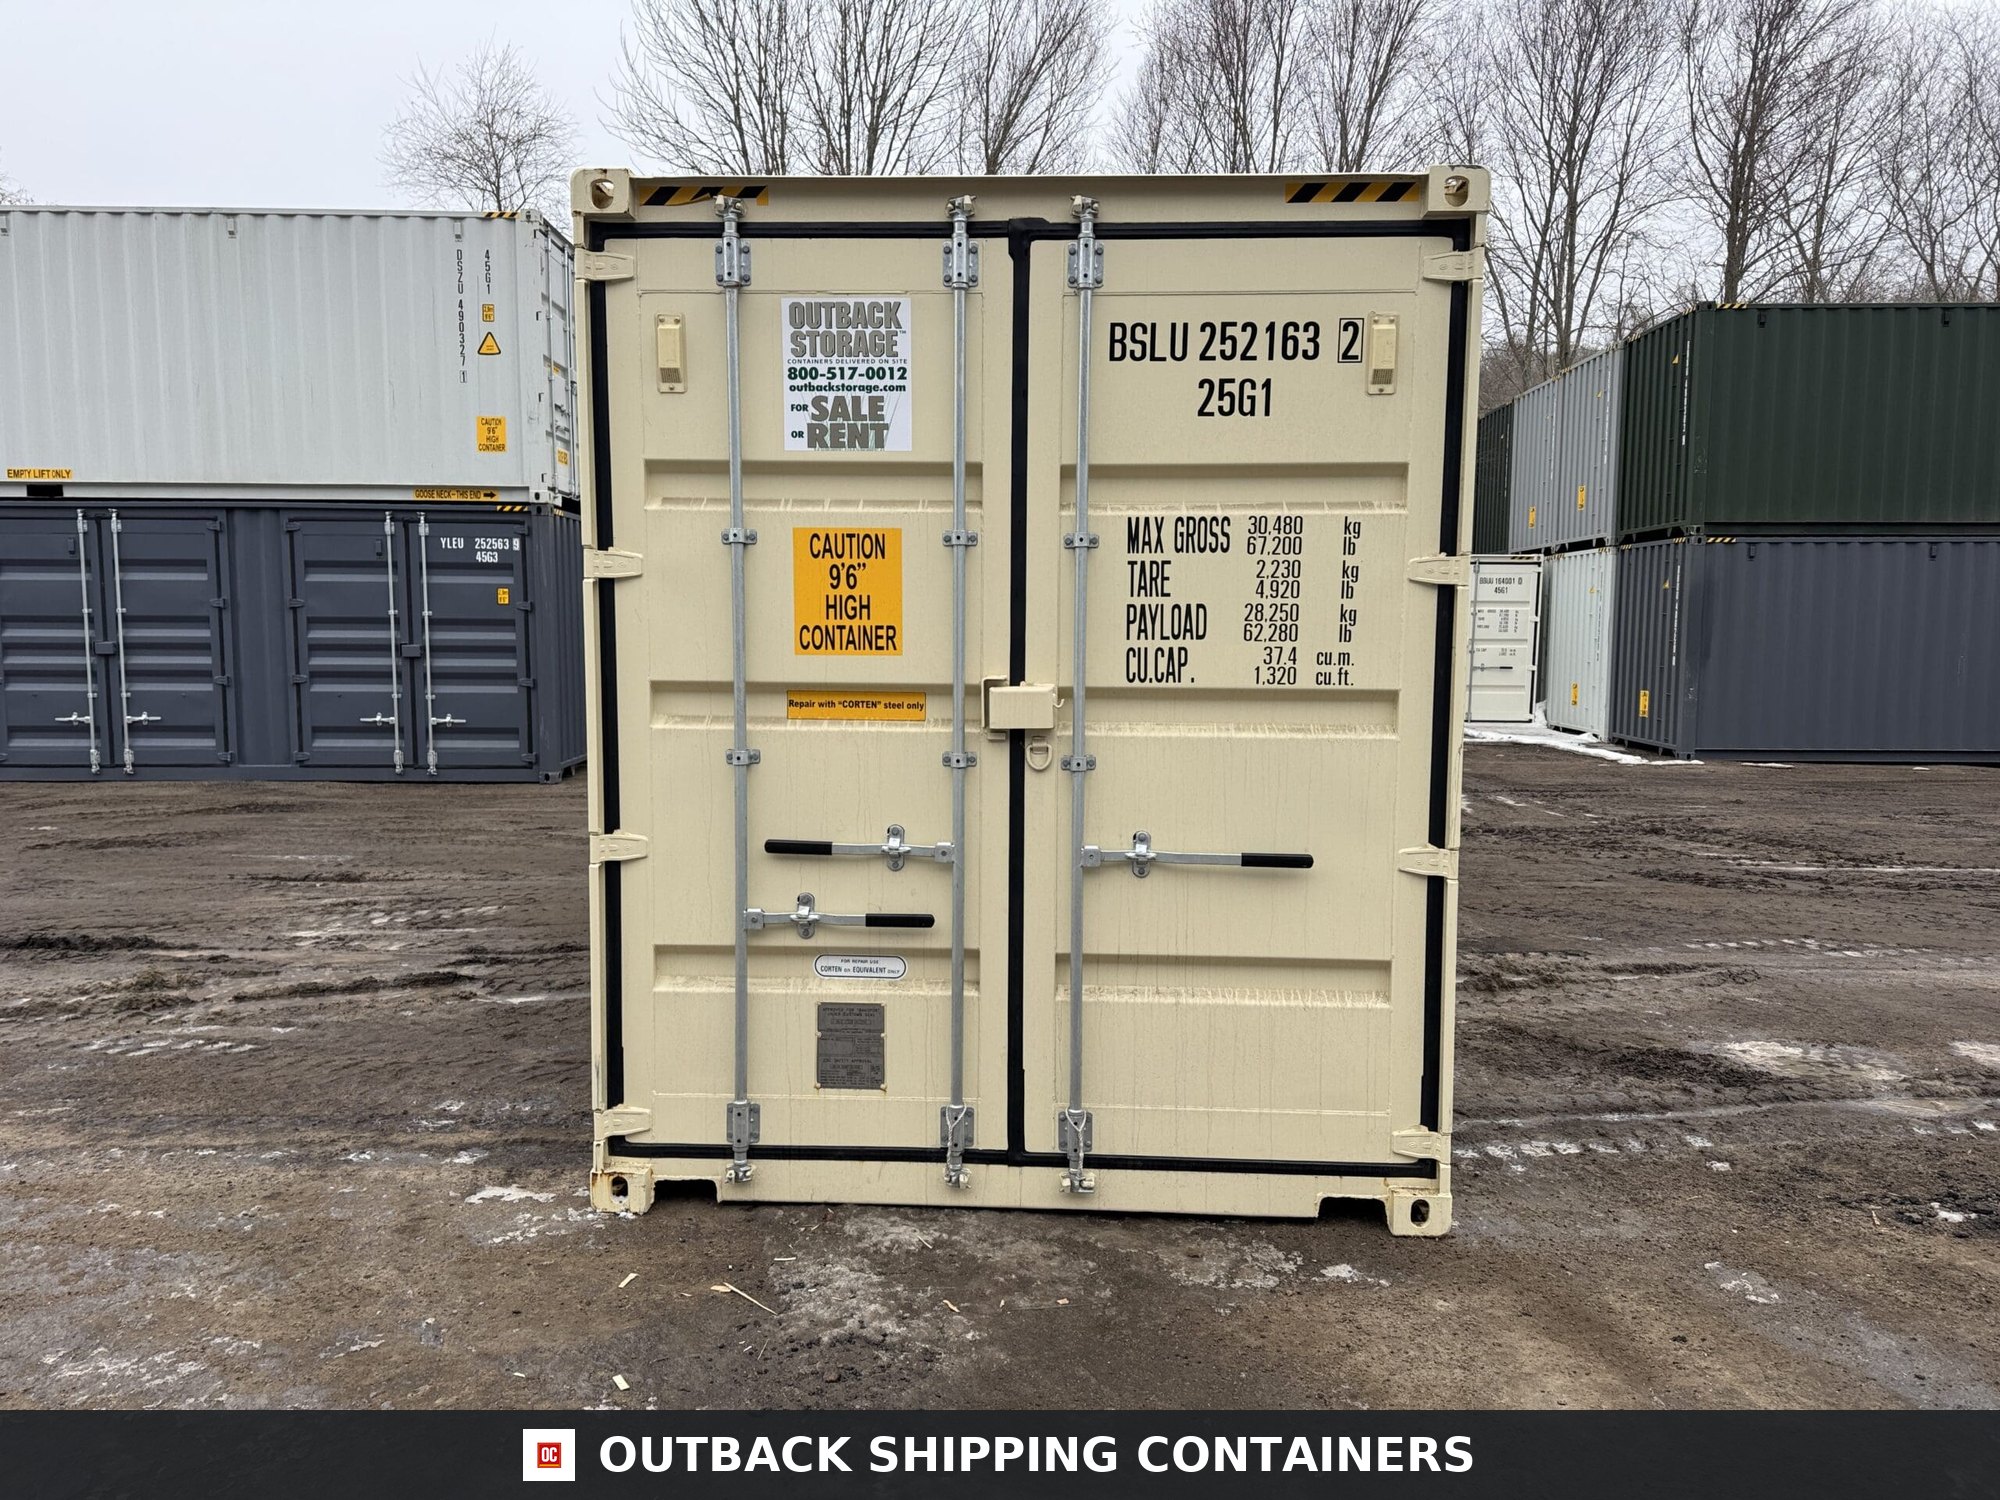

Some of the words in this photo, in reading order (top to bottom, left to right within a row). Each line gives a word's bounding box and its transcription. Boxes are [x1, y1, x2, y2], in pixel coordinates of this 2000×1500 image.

[789, 301, 902, 329] OUTBACK
[458, 299, 466, 366] 490327
[790, 330, 899, 357] STORAGE
[1109, 322, 1188, 361] BSLU
[1199, 321, 1320, 361] 252163
[1341, 321, 1360, 360] 2
[787, 367, 907, 380] 800-517-0012
[789, 382, 906, 393] outbackstorage.com
[1198, 378, 1272, 417] 25G1
[791, 404, 809, 412] FOR
[811, 395, 885, 421] SALE
[807, 423, 889, 448] RENT
[7, 469, 31, 478] EMPTY
[33, 469, 52, 478] LIFT
[52, 469, 71, 478] ONLY
[415, 490, 435, 498] GOOSE
[470, 491, 481, 499] END
[440, 537, 464, 549] YLEU
[474, 537, 509, 550] 252563
[809, 533, 885, 559] CAUTION
[1127, 516, 1165, 554] MAX
[1174, 516, 1231, 553] GROSS
[1344, 516, 1361, 539] kg
[1343, 537, 1356, 555] lb
[1127, 560, 1171, 597] TARE
[1342, 560, 1359, 583] kg
[1341, 581, 1354, 599] lb
[826, 594, 871, 620] HIGH
[1126, 603, 1207, 640] PAYLOAD
[1340, 604, 1357, 627] kg
[1339, 624, 1352, 643] lb
[799, 625, 897, 651] CONTAINER
[1263, 647, 1297, 666] 37.4
[789, 700, 815, 709] Repair
[818, 700, 836, 708] with
[838, 700, 881, 709] "CORTEN"
[883, 701, 904, 709] steel
[906, 701, 924, 711] only
[852, 966, 887, 974] EQUIVALENT
